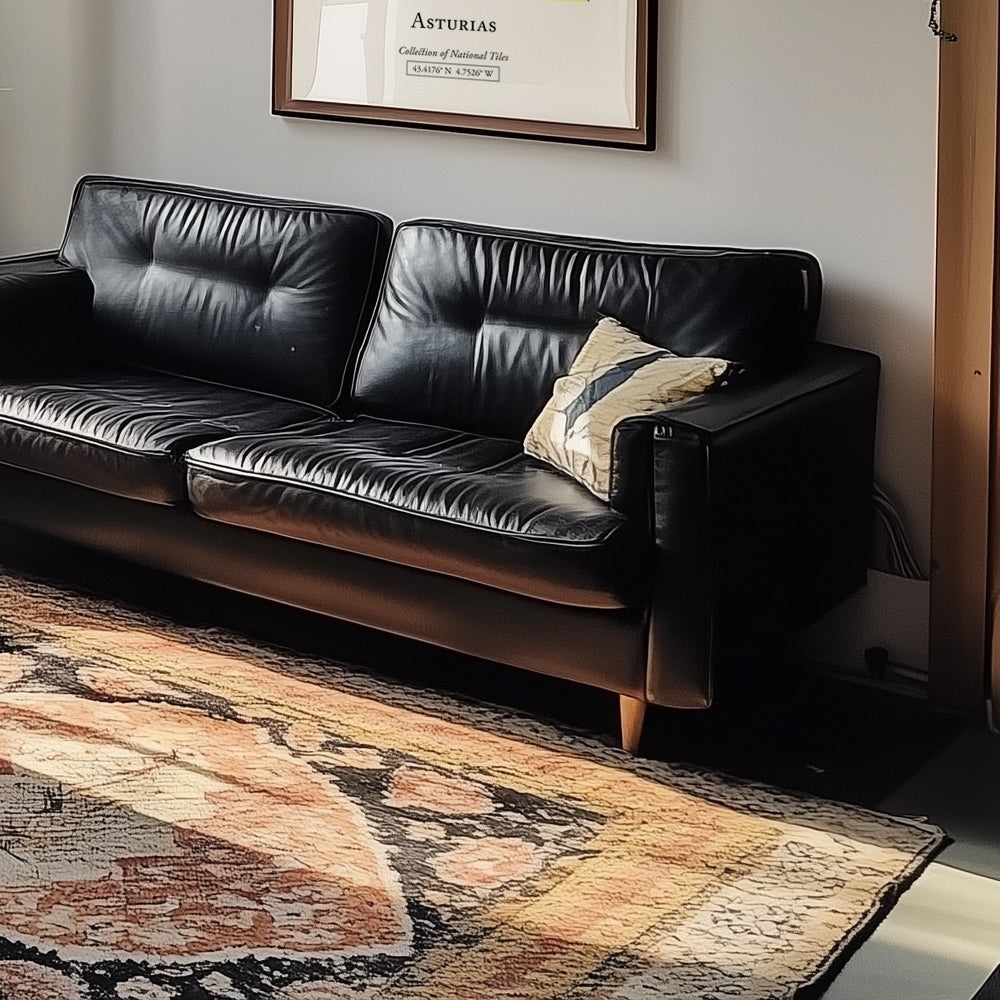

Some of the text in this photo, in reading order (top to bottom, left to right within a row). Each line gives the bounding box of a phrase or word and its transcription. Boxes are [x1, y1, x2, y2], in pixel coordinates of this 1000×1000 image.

[398, 46, 510, 62] Collection of National Tiles
[444, 66, 452, 75] N
[484, 69, 494, 78] W
